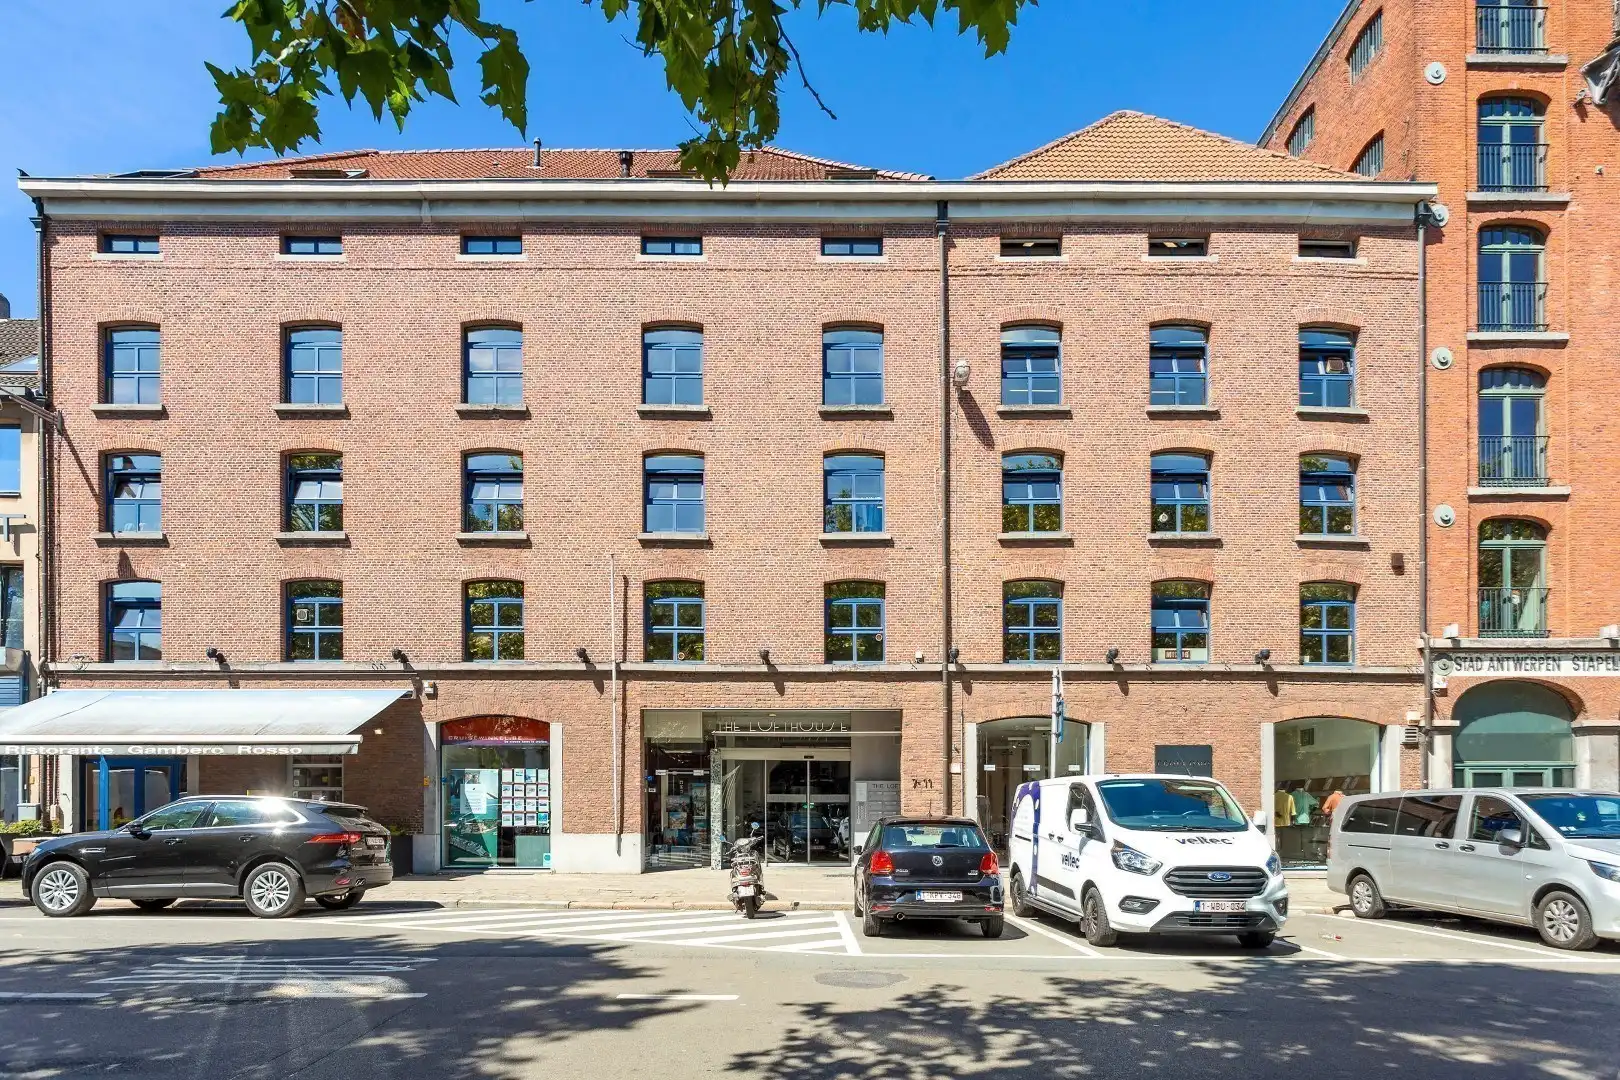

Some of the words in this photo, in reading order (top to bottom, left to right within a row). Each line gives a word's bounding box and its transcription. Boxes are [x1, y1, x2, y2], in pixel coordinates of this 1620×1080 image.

[1454, 655, 1483, 672] STAD
[1487, 655, 1561, 672] ANTWERPEN
[1572, 655, 1620, 672] STAPEL
[4, 745, 115, 755] Ristorante
[128, 745, 224, 755] Gambero
[237, 745, 303, 755] Rosso
[1175, 835, 1233, 845] veltec
